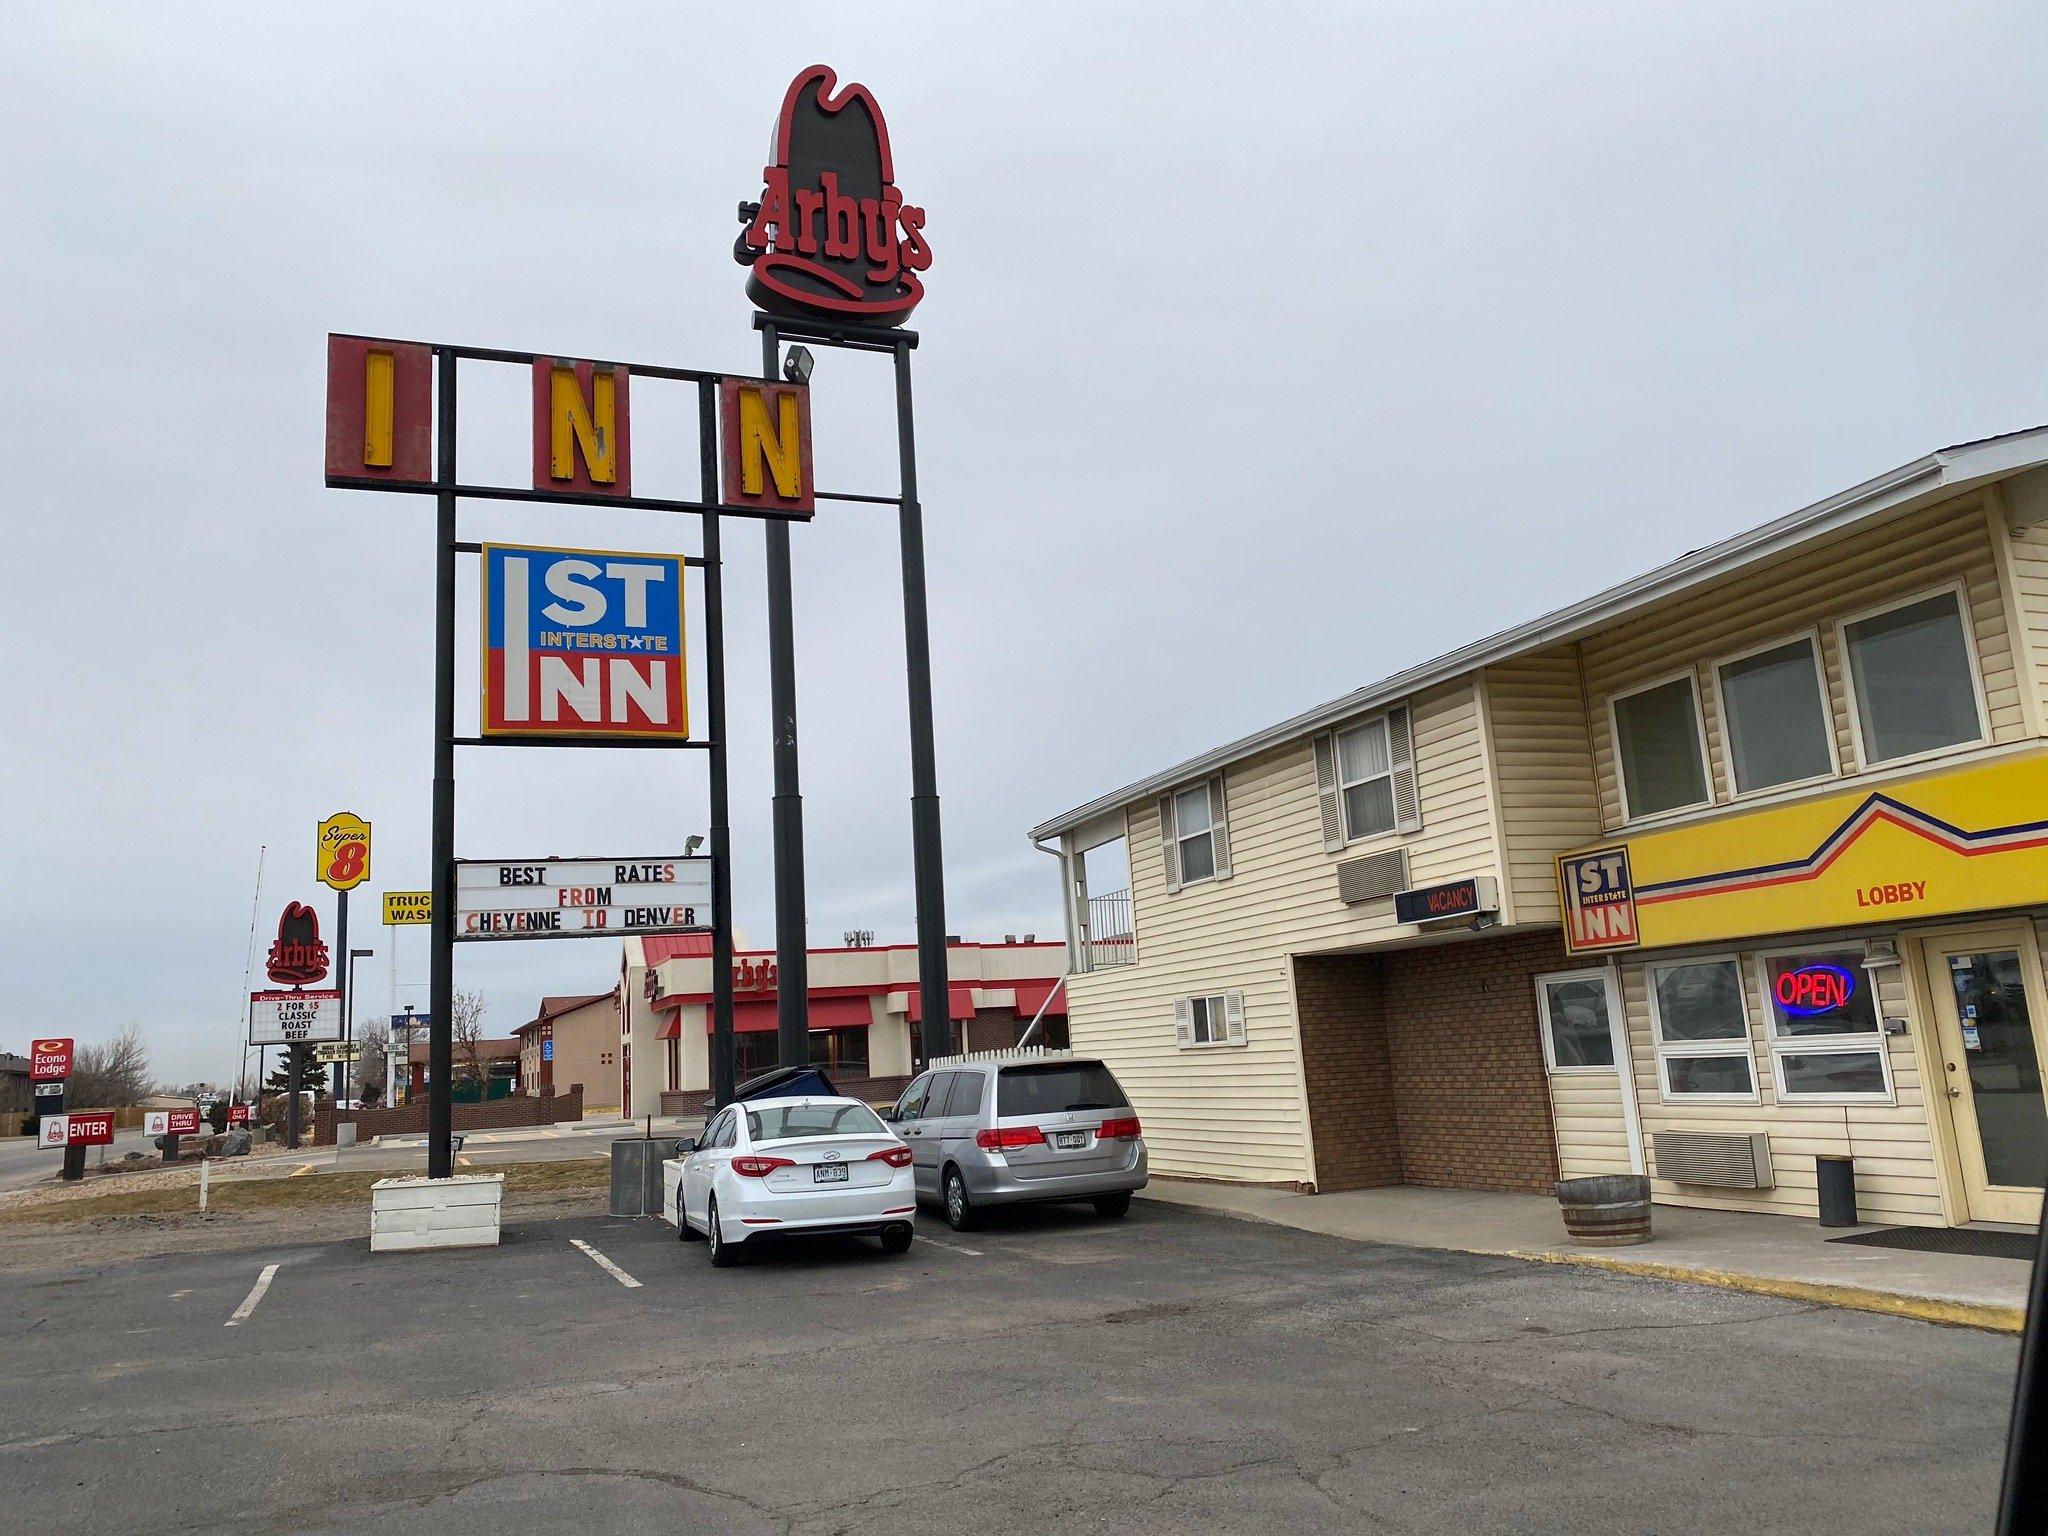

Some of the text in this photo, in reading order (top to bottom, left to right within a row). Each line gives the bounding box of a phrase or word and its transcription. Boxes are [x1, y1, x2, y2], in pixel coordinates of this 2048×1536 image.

[746, 166, 932, 282] Arby's
[322, 826, 367, 850] Super
[327, 842, 367, 882] 8
[500, 863, 675, 886] BEST RATES
[387, 895, 431, 907] TRUC
[558, 886, 612, 907] FROM
[1427, 886, 1474, 913] VACANCY
[1856, 880, 1927, 907] LOBBY
[465, 906, 695, 933] CHEYENNE TO DENVER
[266, 938, 330, 973] Arby's
[732, 959, 778, 993] rby's
[260, 994, 302, 1002] Drive-Thru
[1775, 971, 1845, 1008] OPEN
[276, 1001, 319, 1011] 2 FOR $5
[278, 1011, 317, 1020] CLASSIC
[281, 1021, 312, 1030] ROAST
[285, 1030, 308, 1039] BEEF
[35, 1053, 66, 1064] Econo
[34, 1064, 66, 1076] Lodge
[69, 1121, 107, 1137] ENTER
